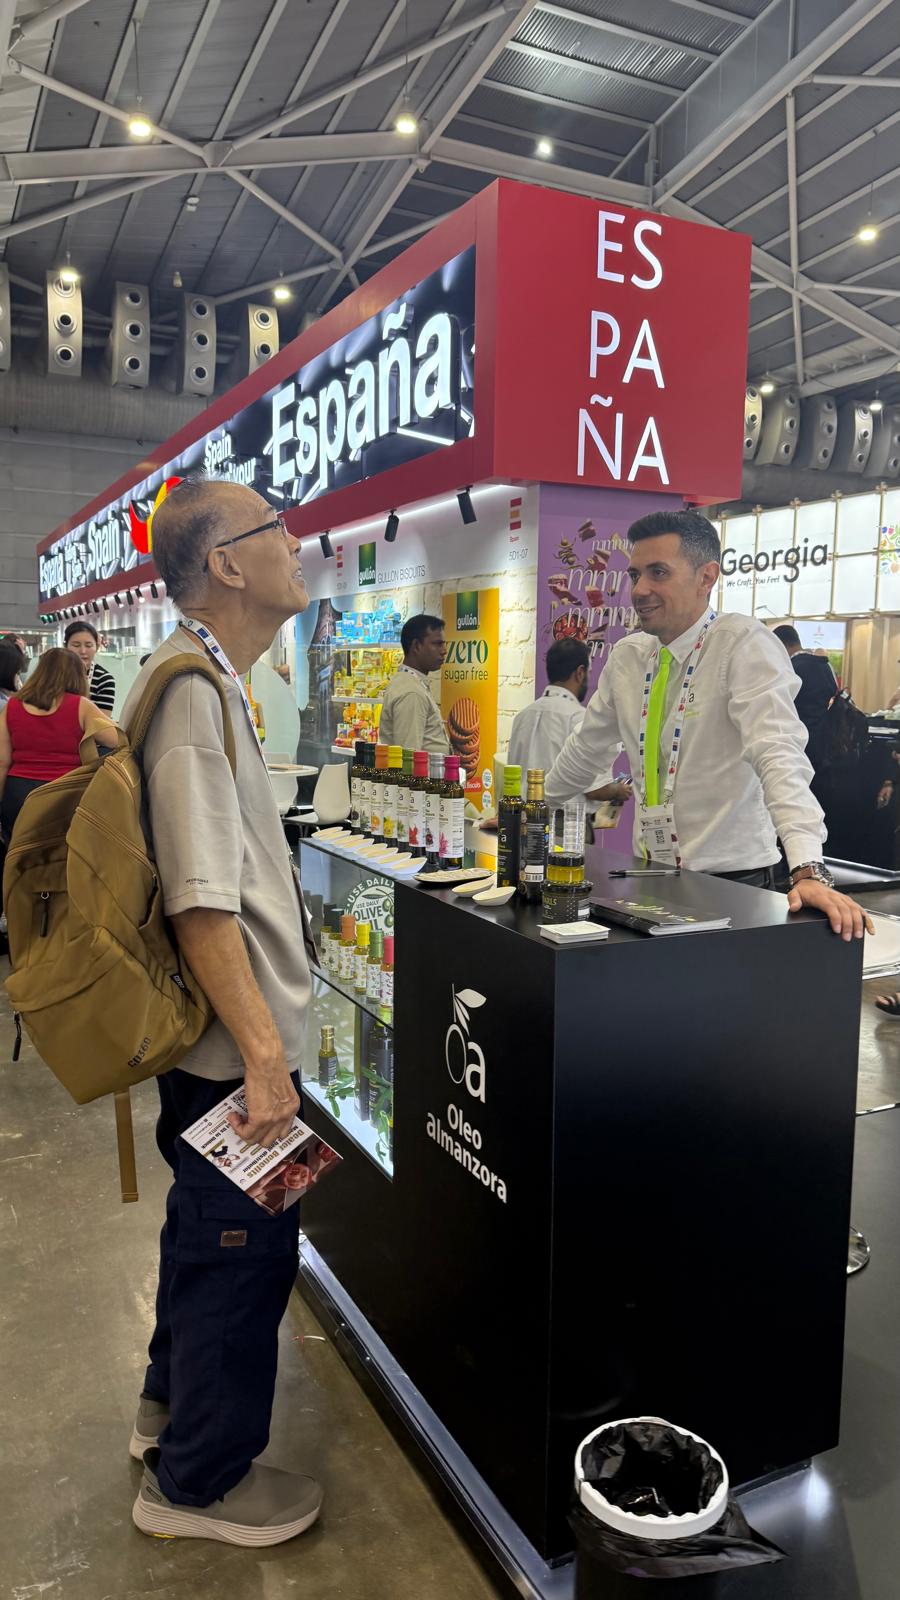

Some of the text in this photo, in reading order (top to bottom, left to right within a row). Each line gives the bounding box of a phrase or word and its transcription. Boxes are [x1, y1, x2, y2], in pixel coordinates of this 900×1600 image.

[597, 210, 663, 290] ES
[589, 310, 665, 389] PA
[272, 302, 452, 489] España
[204, 429, 233, 472] Spain
[577, 394, 670, 485] ÑA
[88, 510, 120, 580] Spain
[720, 537, 829, 583] Georgia
[767, 575, 780, 584] Feel
[457, 613, 477, 632] gullón
[444, 666, 489, 683] sugar free
[445, 639, 489, 664] zero
[347, 881, 365, 903] USE
[353, 905, 383, 922] OLIVE
[447, 1103, 482, 1150] Oleo
[426, 1112, 507, 1204] almanzora
